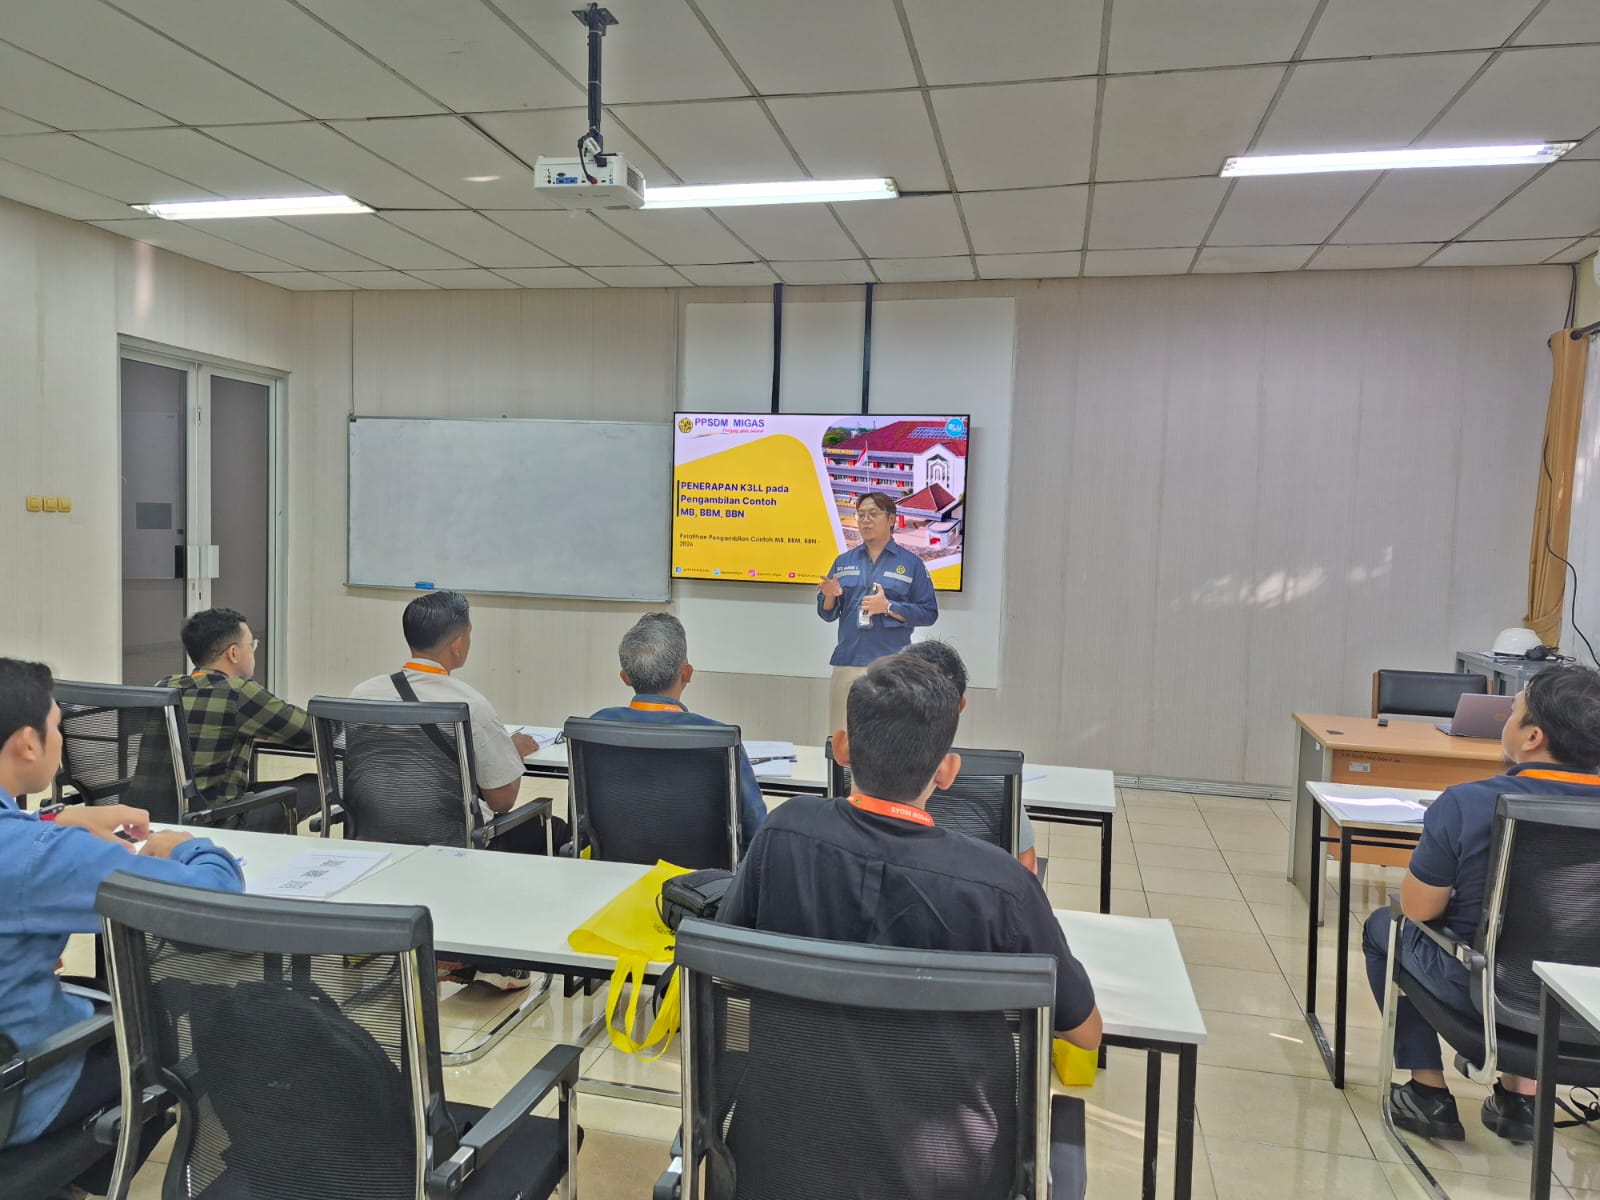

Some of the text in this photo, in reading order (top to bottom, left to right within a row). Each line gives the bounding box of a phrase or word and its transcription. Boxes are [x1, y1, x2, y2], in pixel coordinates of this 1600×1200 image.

[694, 418, 765, 428] PPSDM MIGAS
[680, 481, 789, 494] PENERAPAN K3LL pada
[680, 494, 777, 506] Pengambilan Contoh
[680, 508, 745, 519] MB, BBM, BBN
[708, 534, 749, 542] Pengambilan
